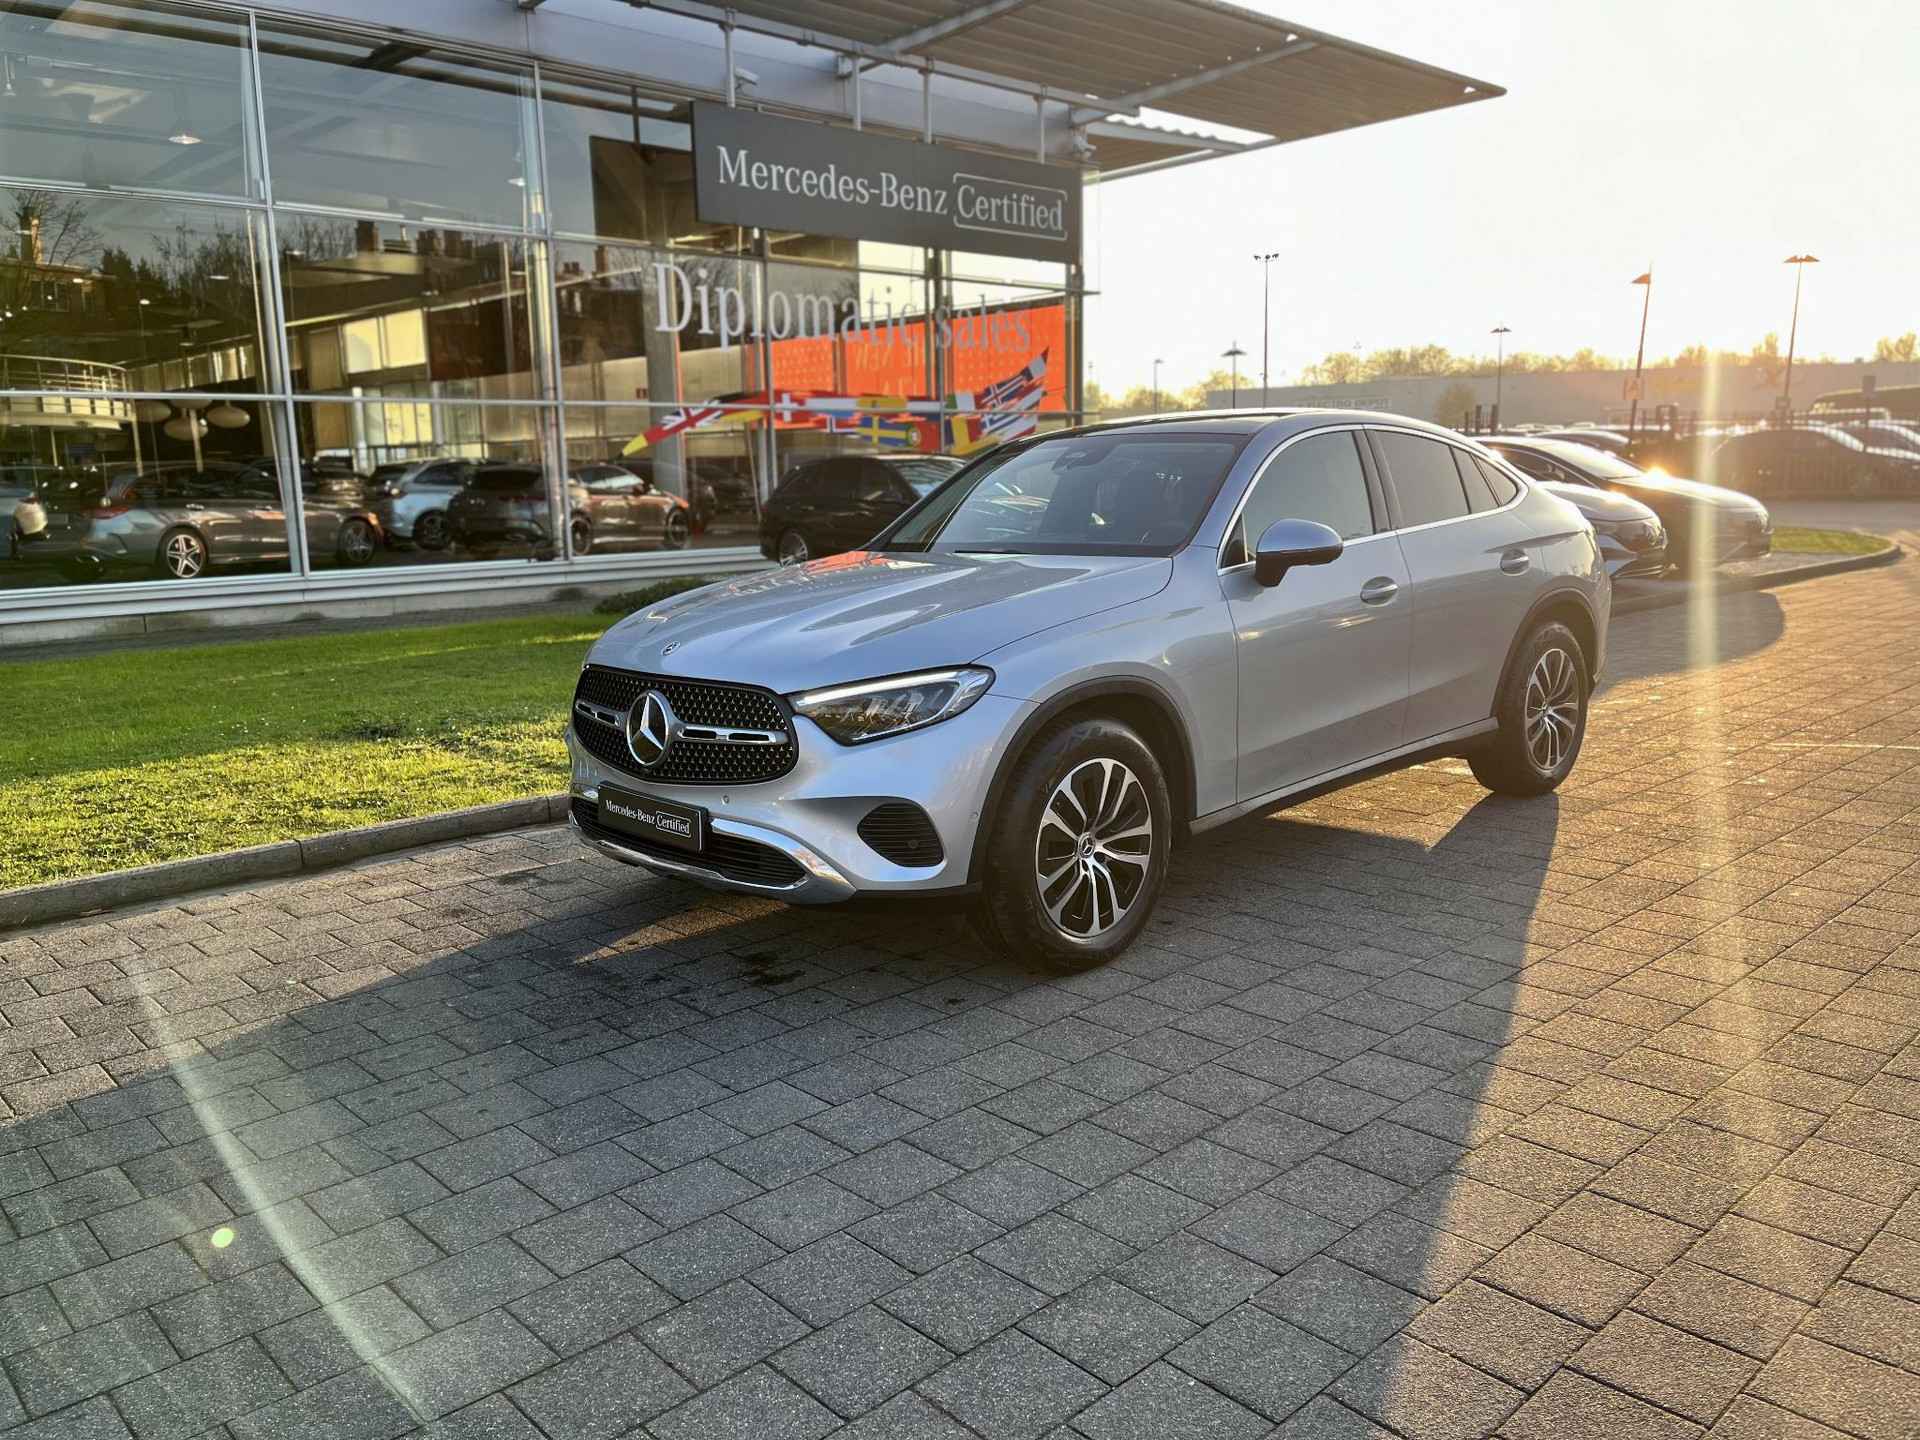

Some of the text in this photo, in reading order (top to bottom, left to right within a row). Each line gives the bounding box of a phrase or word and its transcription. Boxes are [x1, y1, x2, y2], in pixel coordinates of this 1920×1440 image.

[716, 145, 1063, 231] Mercedes-Benz Certified
[654, 263, 917, 352] Diplomatic
[935, 294, 1030, 353] sales
[606, 799, 690, 834] Mercedes-Benz Certified
